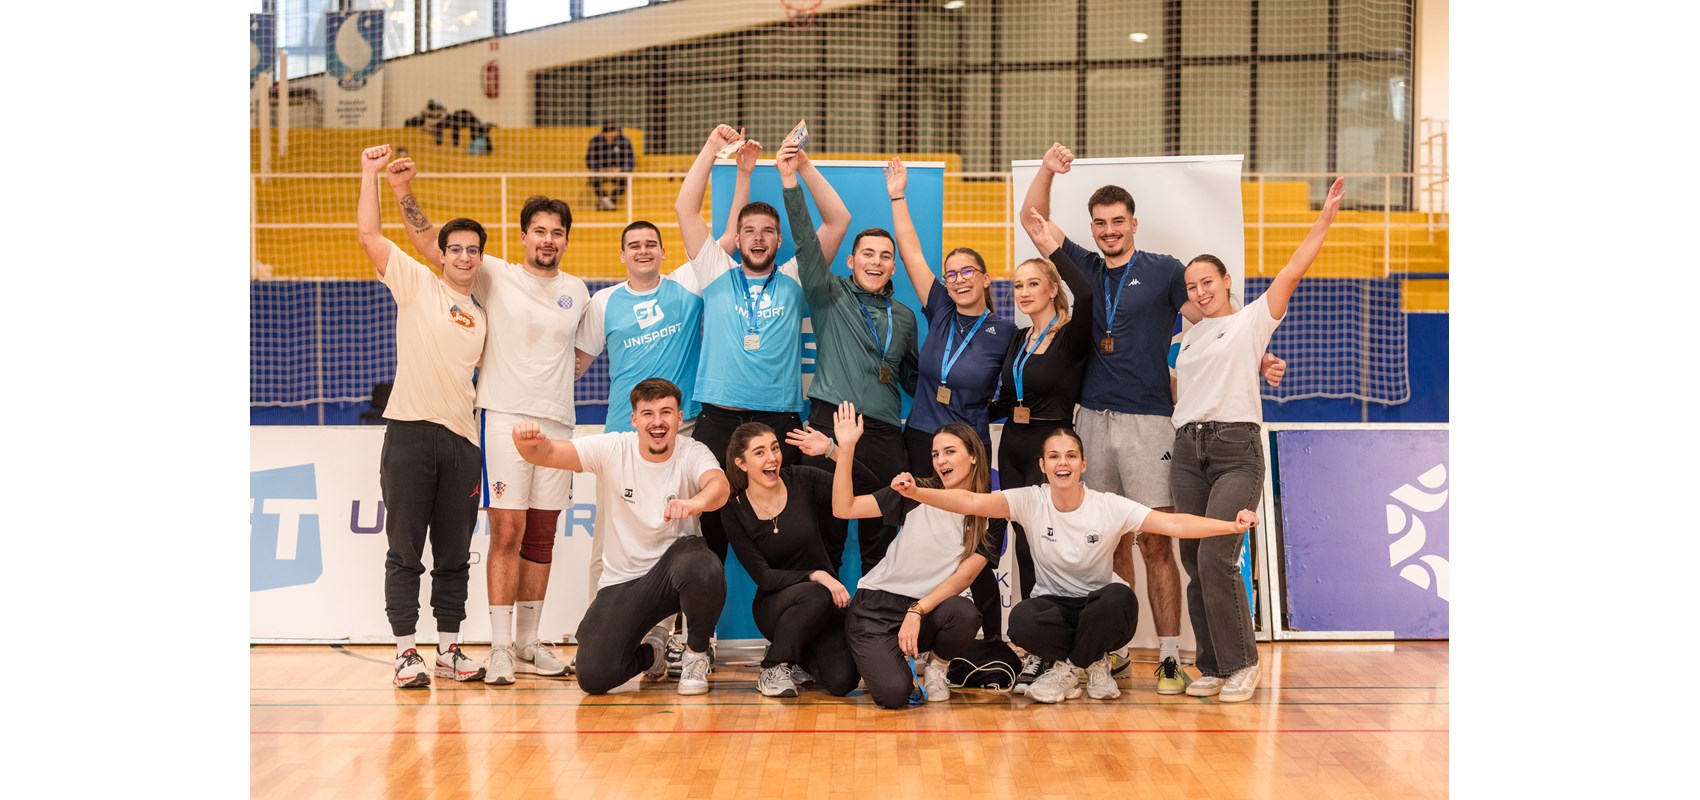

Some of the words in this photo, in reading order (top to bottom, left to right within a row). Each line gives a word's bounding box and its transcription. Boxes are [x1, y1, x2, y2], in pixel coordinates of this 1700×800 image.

[453, 312, 471, 326] Jeep
[623, 322, 682, 349] UNISPORT
[250, 498, 318, 560] T
